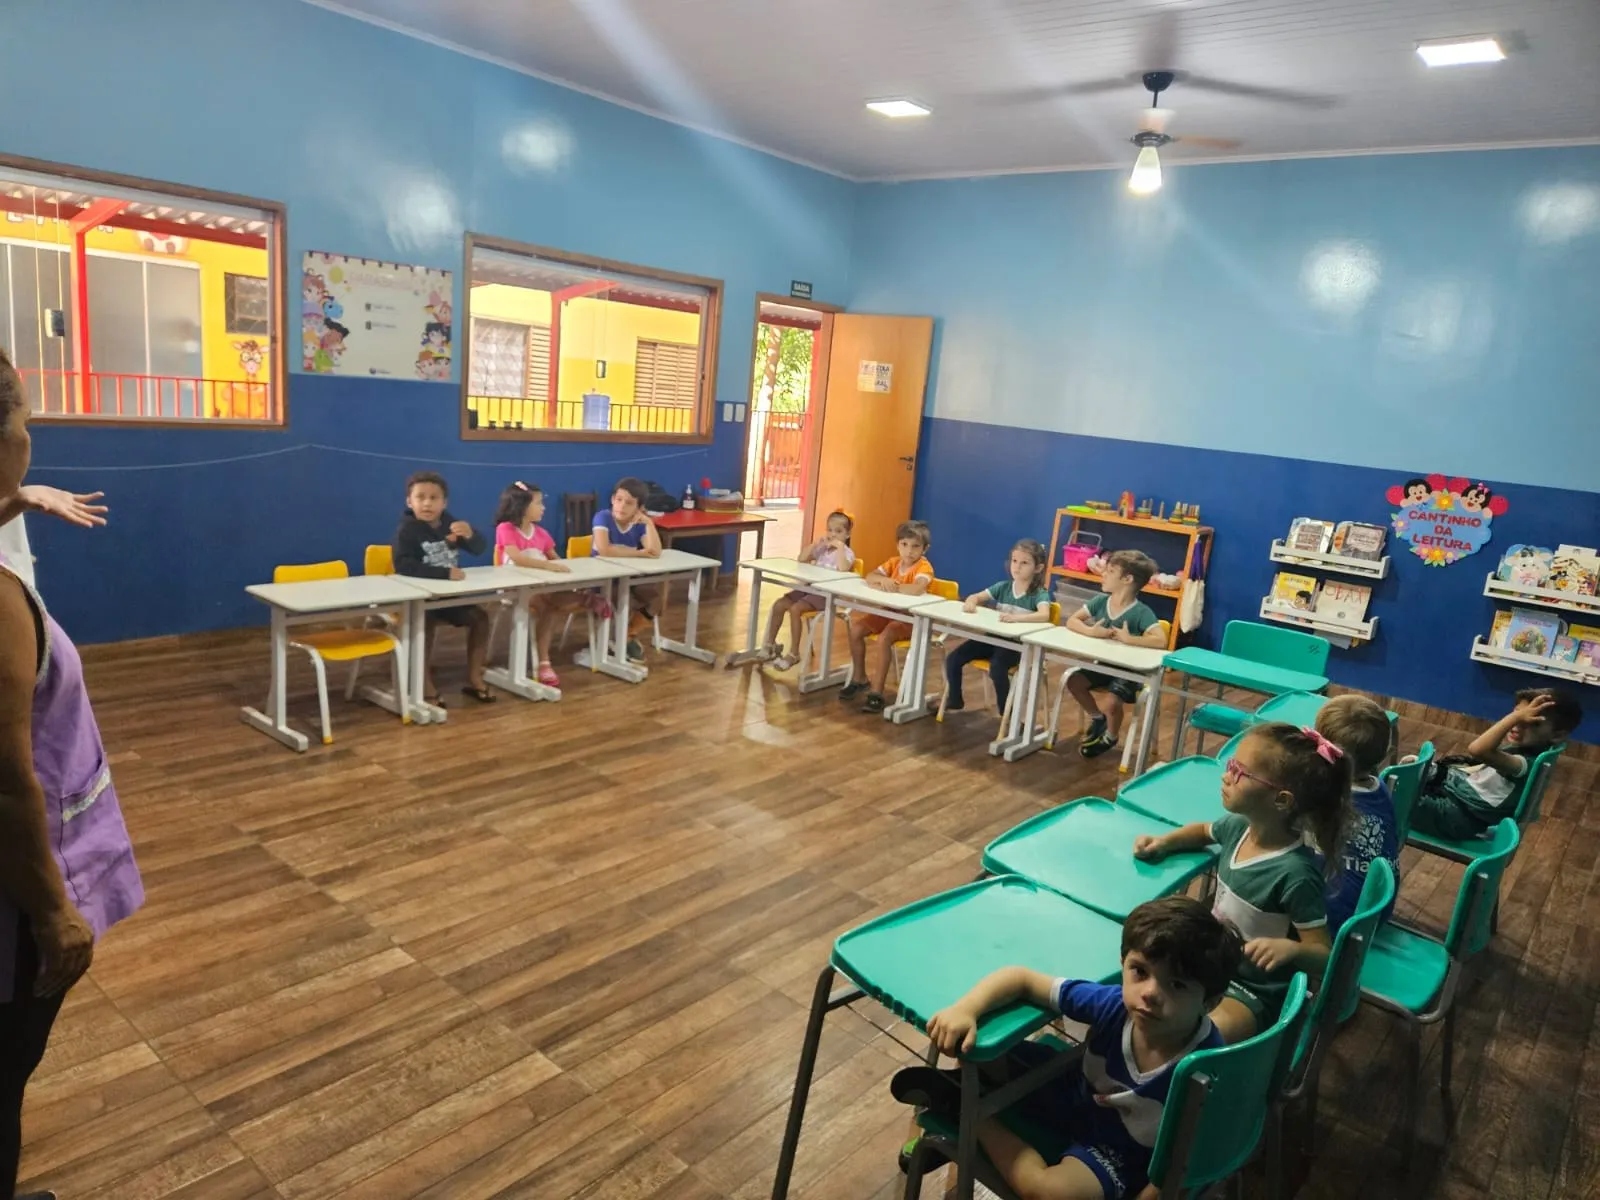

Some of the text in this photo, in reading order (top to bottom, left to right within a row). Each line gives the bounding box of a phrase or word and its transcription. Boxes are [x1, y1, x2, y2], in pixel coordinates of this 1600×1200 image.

[1408, 510, 1481, 528] CANTINHO
[1434, 524, 1453, 537] DA
[1411, 533, 1472, 551] LEITURA
